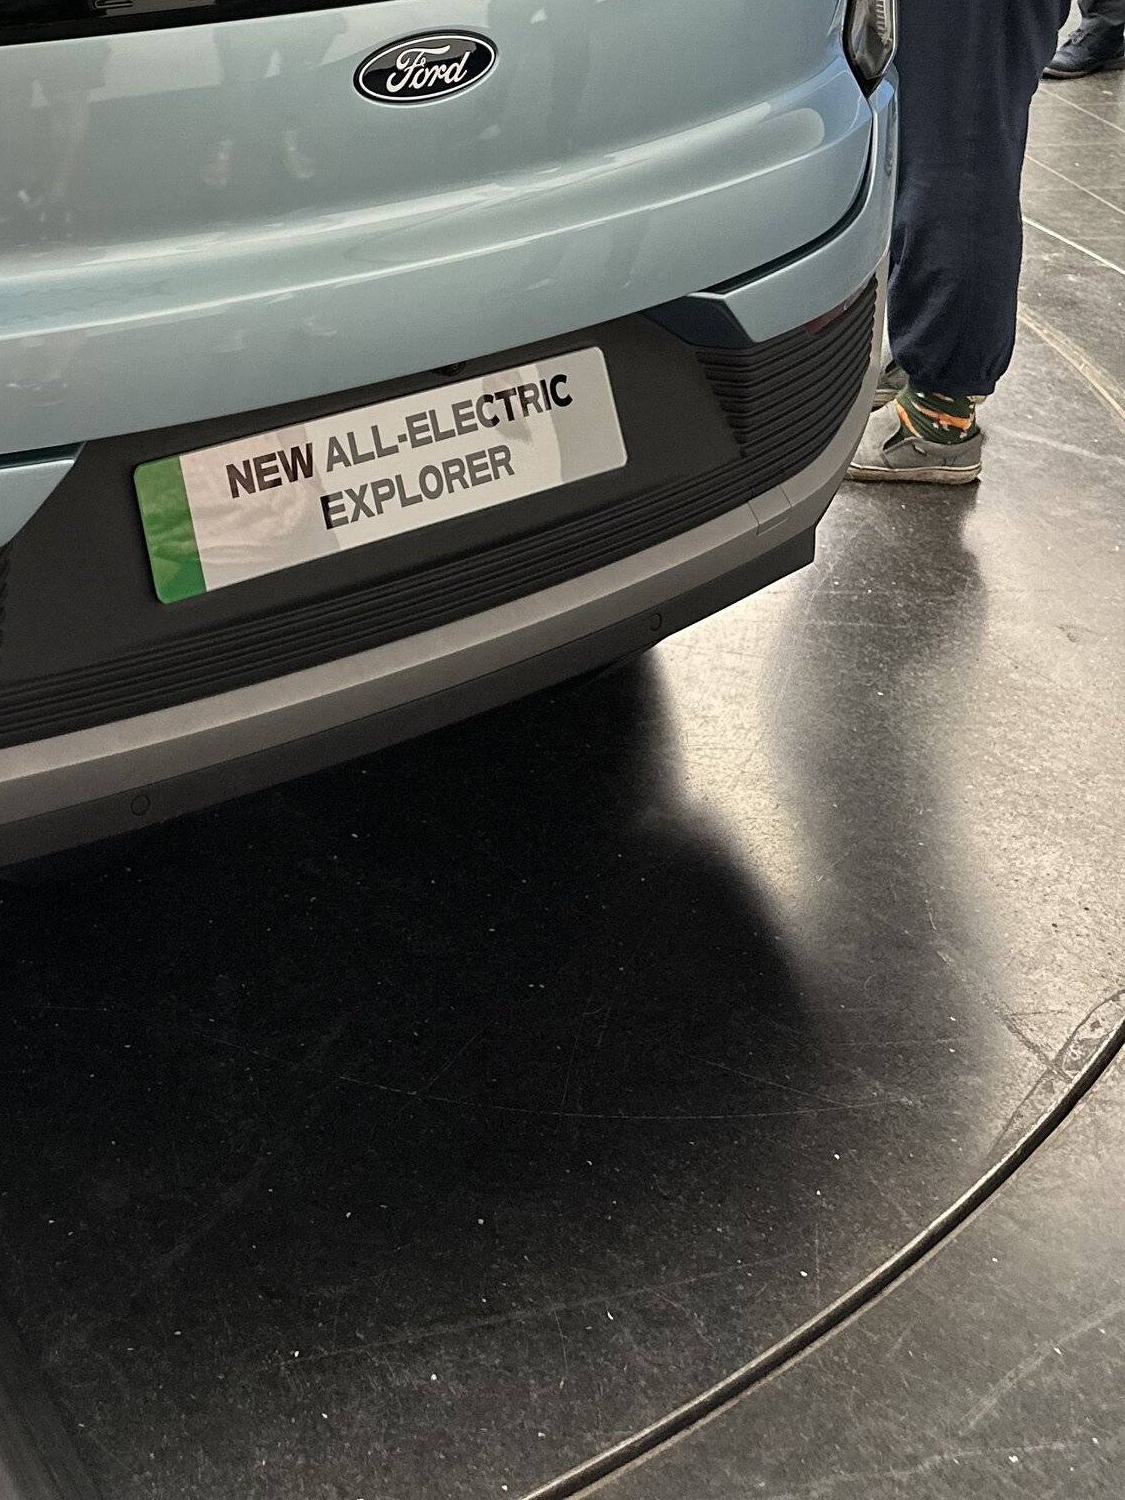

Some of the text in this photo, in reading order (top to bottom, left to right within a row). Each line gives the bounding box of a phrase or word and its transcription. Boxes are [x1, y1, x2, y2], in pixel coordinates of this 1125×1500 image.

[385, 44, 471, 93] Ford
[225, 374, 574, 498] NEW ALL-ELECTRIC
[321, 444, 515, 530] EXPLORER
